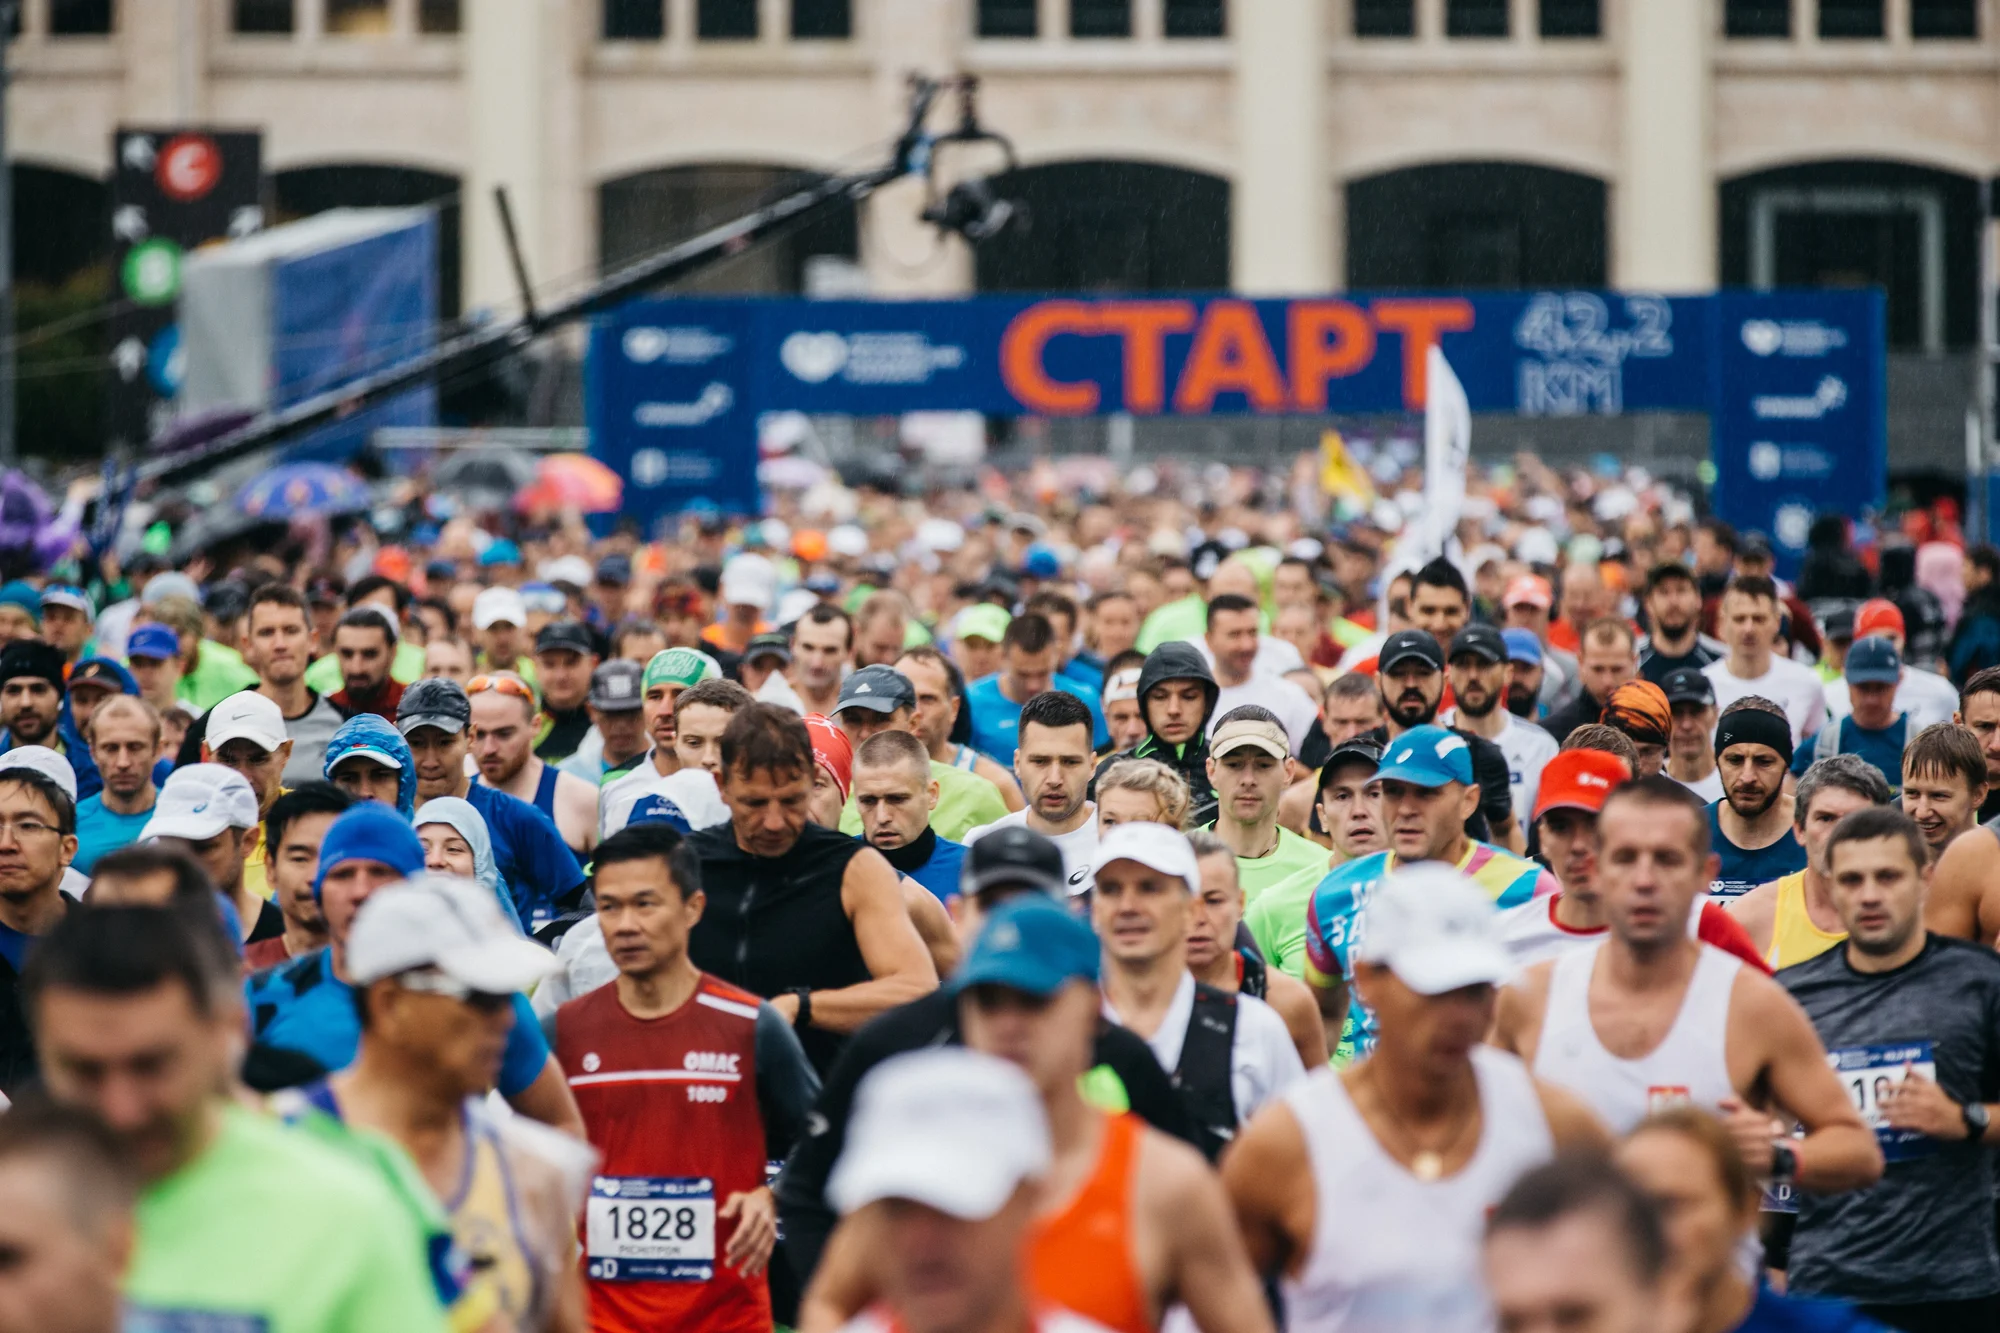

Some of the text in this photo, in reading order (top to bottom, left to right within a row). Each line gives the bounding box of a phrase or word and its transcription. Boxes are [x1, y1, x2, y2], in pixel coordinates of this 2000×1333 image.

[1001, 299, 1475, 413] СТАРТ
[1779, 1184, 1791, 1201] D
[608, 1206, 695, 1240] 1828
[602, 1258, 618, 1279] D
